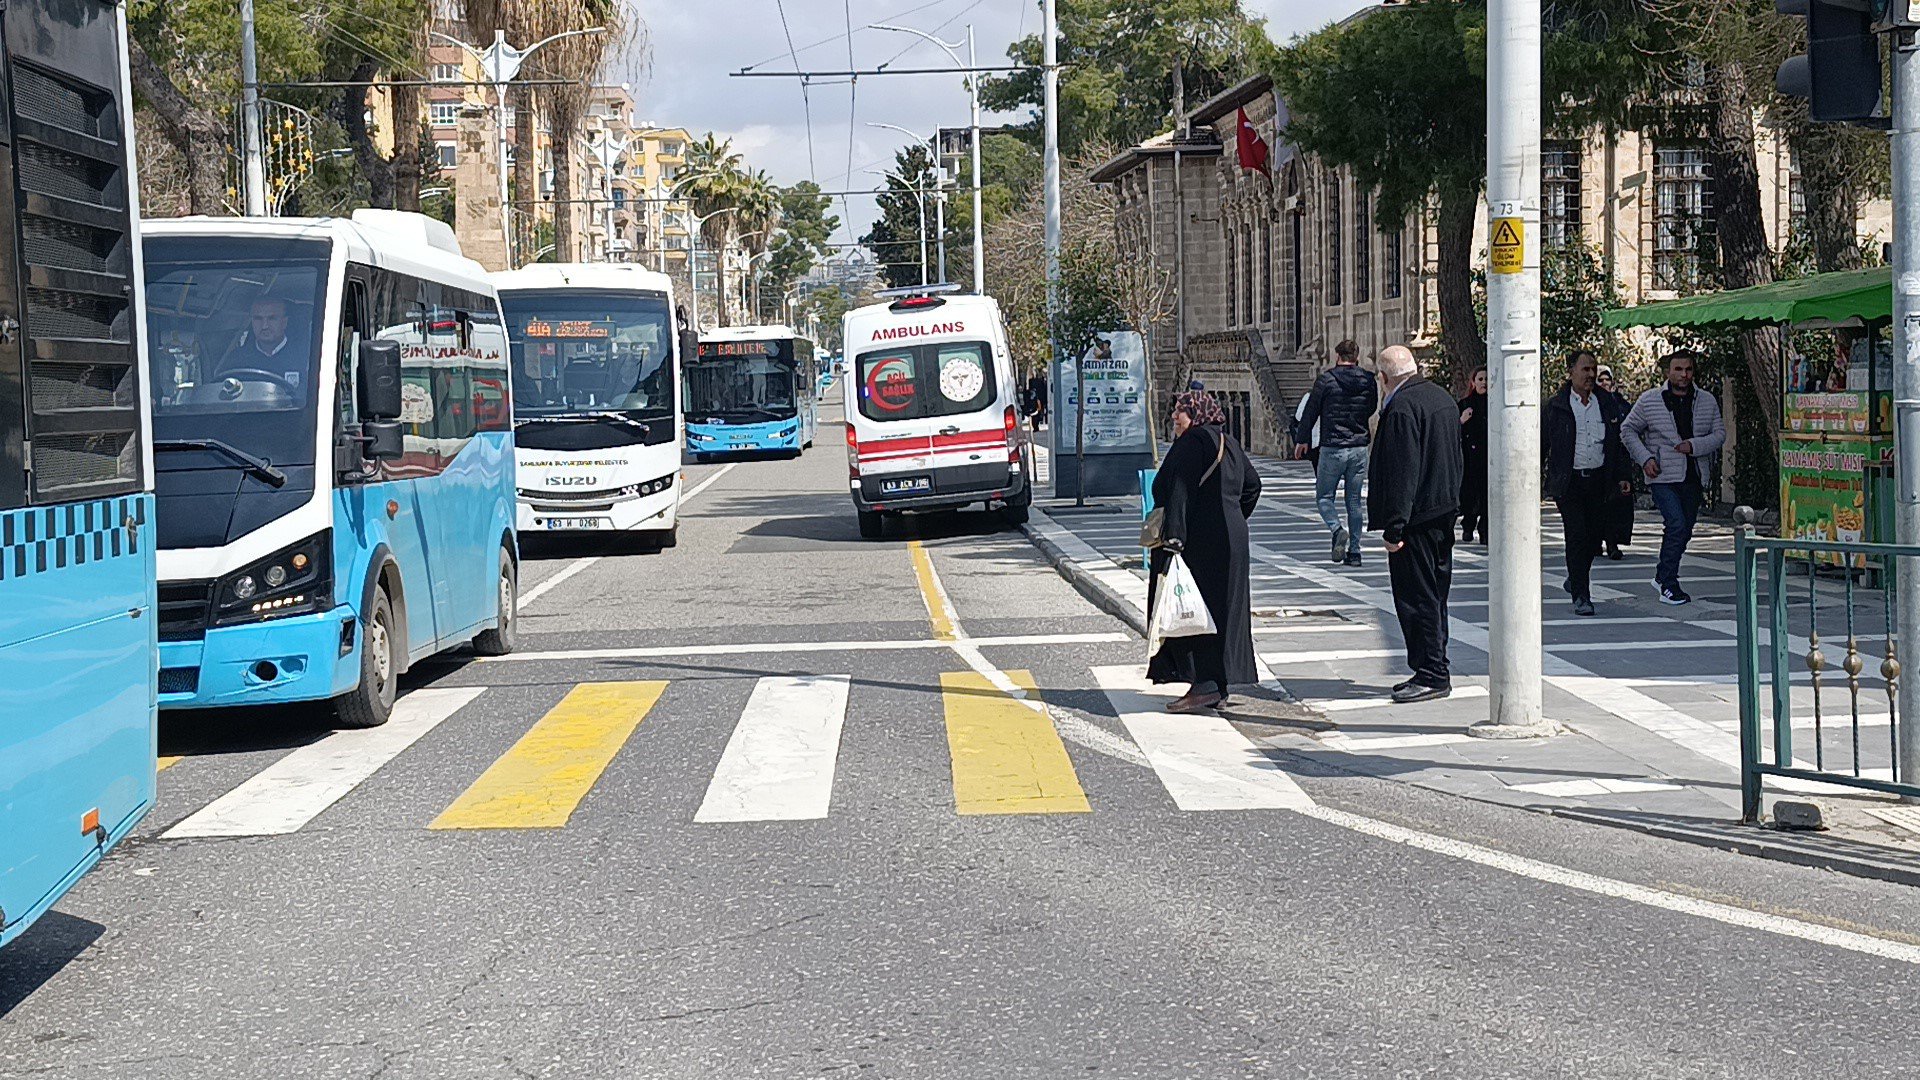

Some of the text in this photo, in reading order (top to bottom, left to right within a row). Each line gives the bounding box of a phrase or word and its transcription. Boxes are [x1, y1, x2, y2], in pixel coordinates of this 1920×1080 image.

[1500, 203, 1513, 215] 73
[871, 321, 965, 341] AMBULANS
[1082, 360, 1129, 370] AMAZAN
[546, 476, 597, 485] ISUZU
